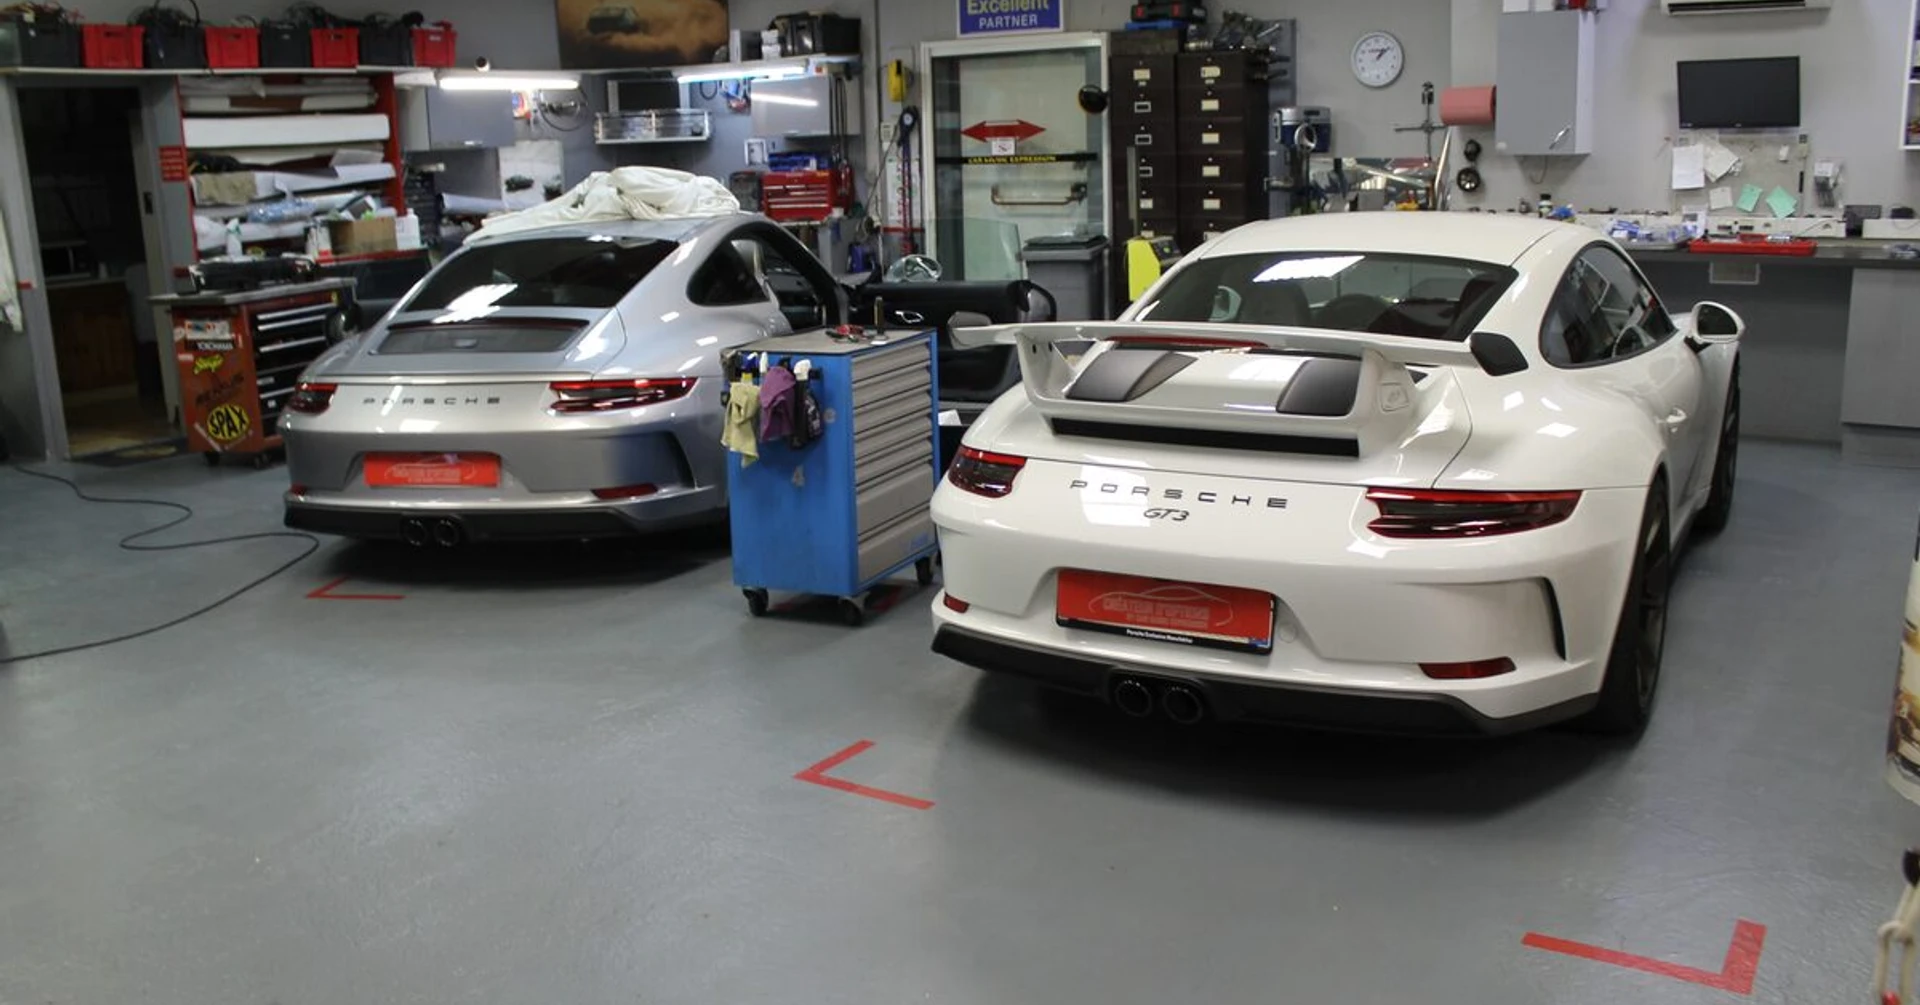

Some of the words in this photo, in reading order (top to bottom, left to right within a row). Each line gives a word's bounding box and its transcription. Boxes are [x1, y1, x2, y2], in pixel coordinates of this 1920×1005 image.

[967, 0, 1049, 15] Excellent
[979, 14, 1038, 30] PARTNER
[363, 396, 500, 405] PORSCHE
[209, 405, 248, 438] SPAX
[1070, 479, 1288, 509] PORSCHE
[1143, 507, 1190, 521] GT3
